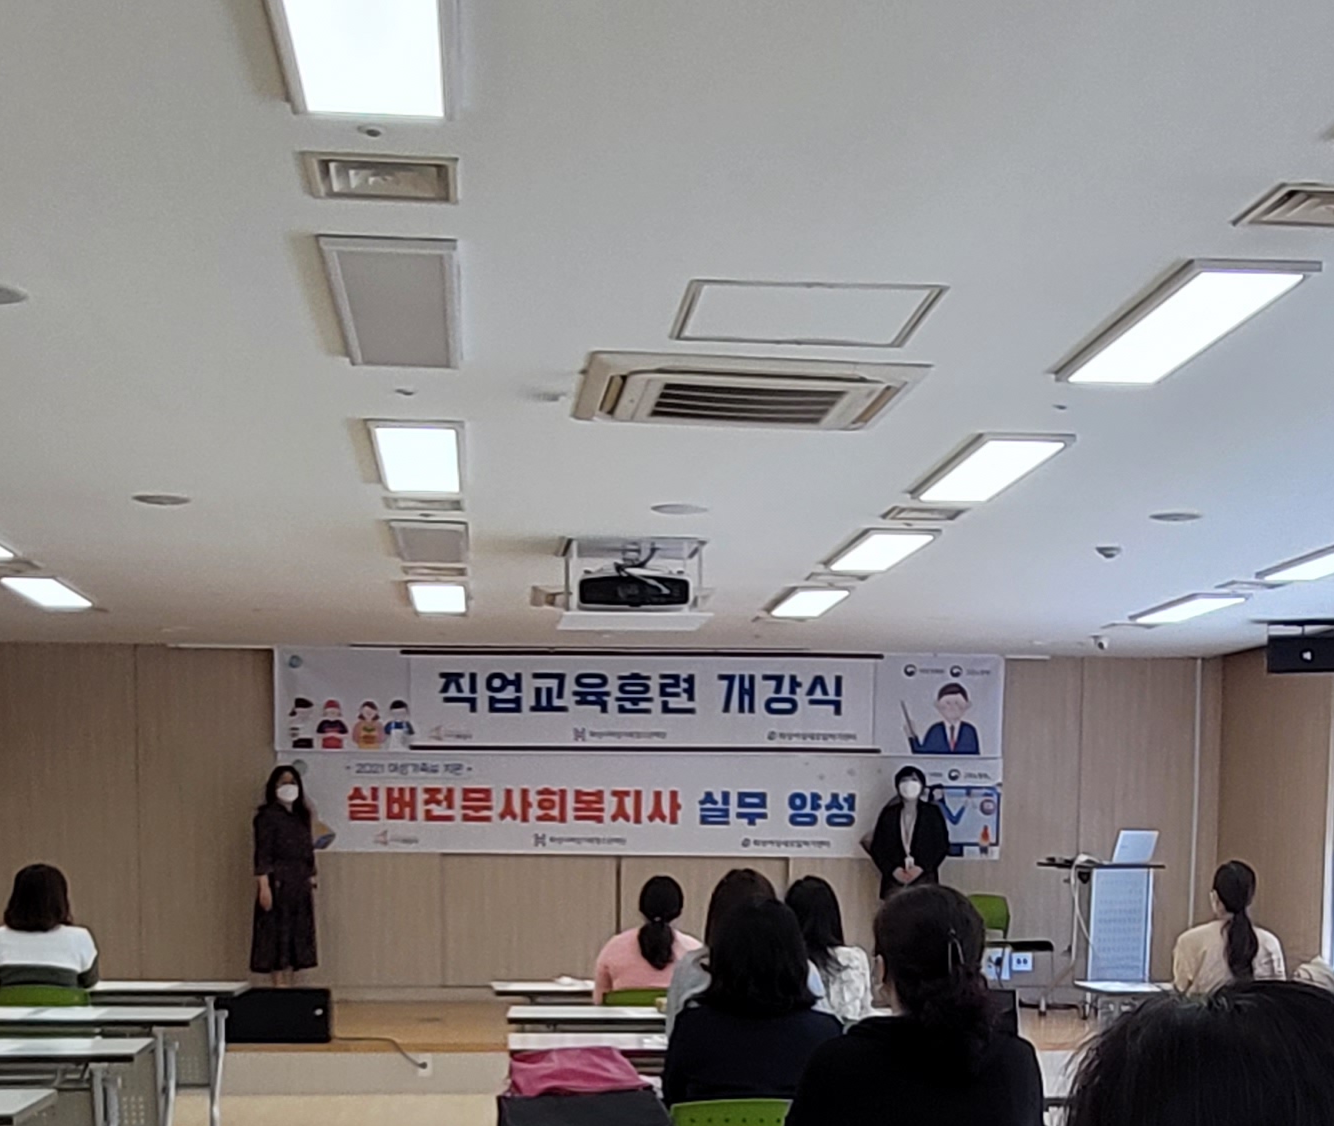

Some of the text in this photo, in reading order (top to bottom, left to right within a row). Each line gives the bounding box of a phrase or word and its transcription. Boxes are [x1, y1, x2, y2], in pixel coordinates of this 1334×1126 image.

[438, 671, 844, 717] 직업교육훈련 개강식
[347, 786, 857, 827] 실버전문사회복지사 실무 양성
